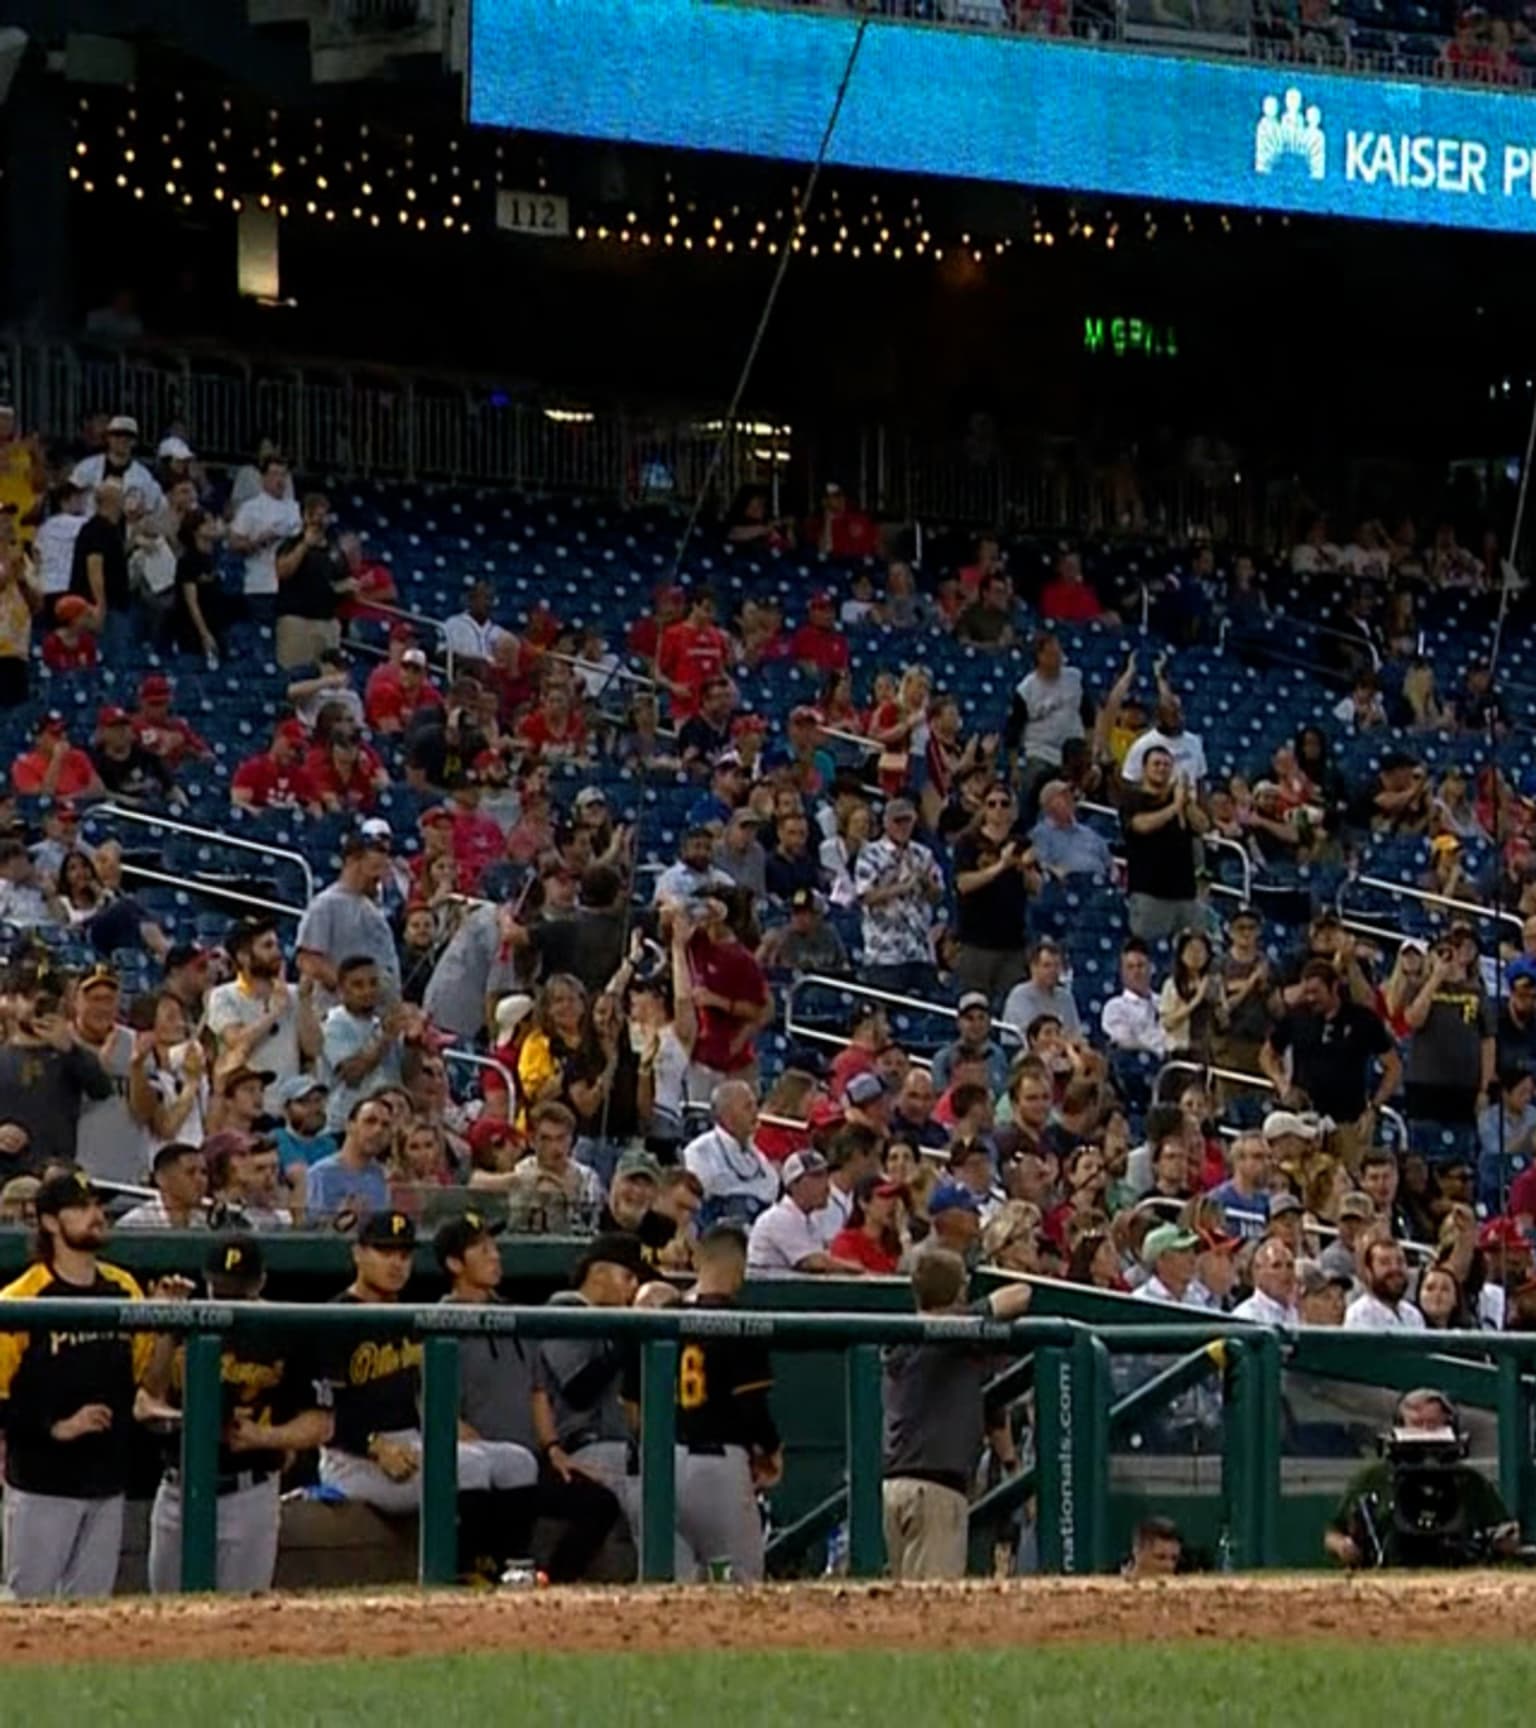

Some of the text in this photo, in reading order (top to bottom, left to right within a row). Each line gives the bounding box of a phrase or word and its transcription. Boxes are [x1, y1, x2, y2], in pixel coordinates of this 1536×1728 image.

[1346, 130, 1487, 195] KAISER
[511, 199, 556, 229] 112
[224, 1248, 242, 1271] P
[1056, 1363, 1075, 1572] nationals.com
